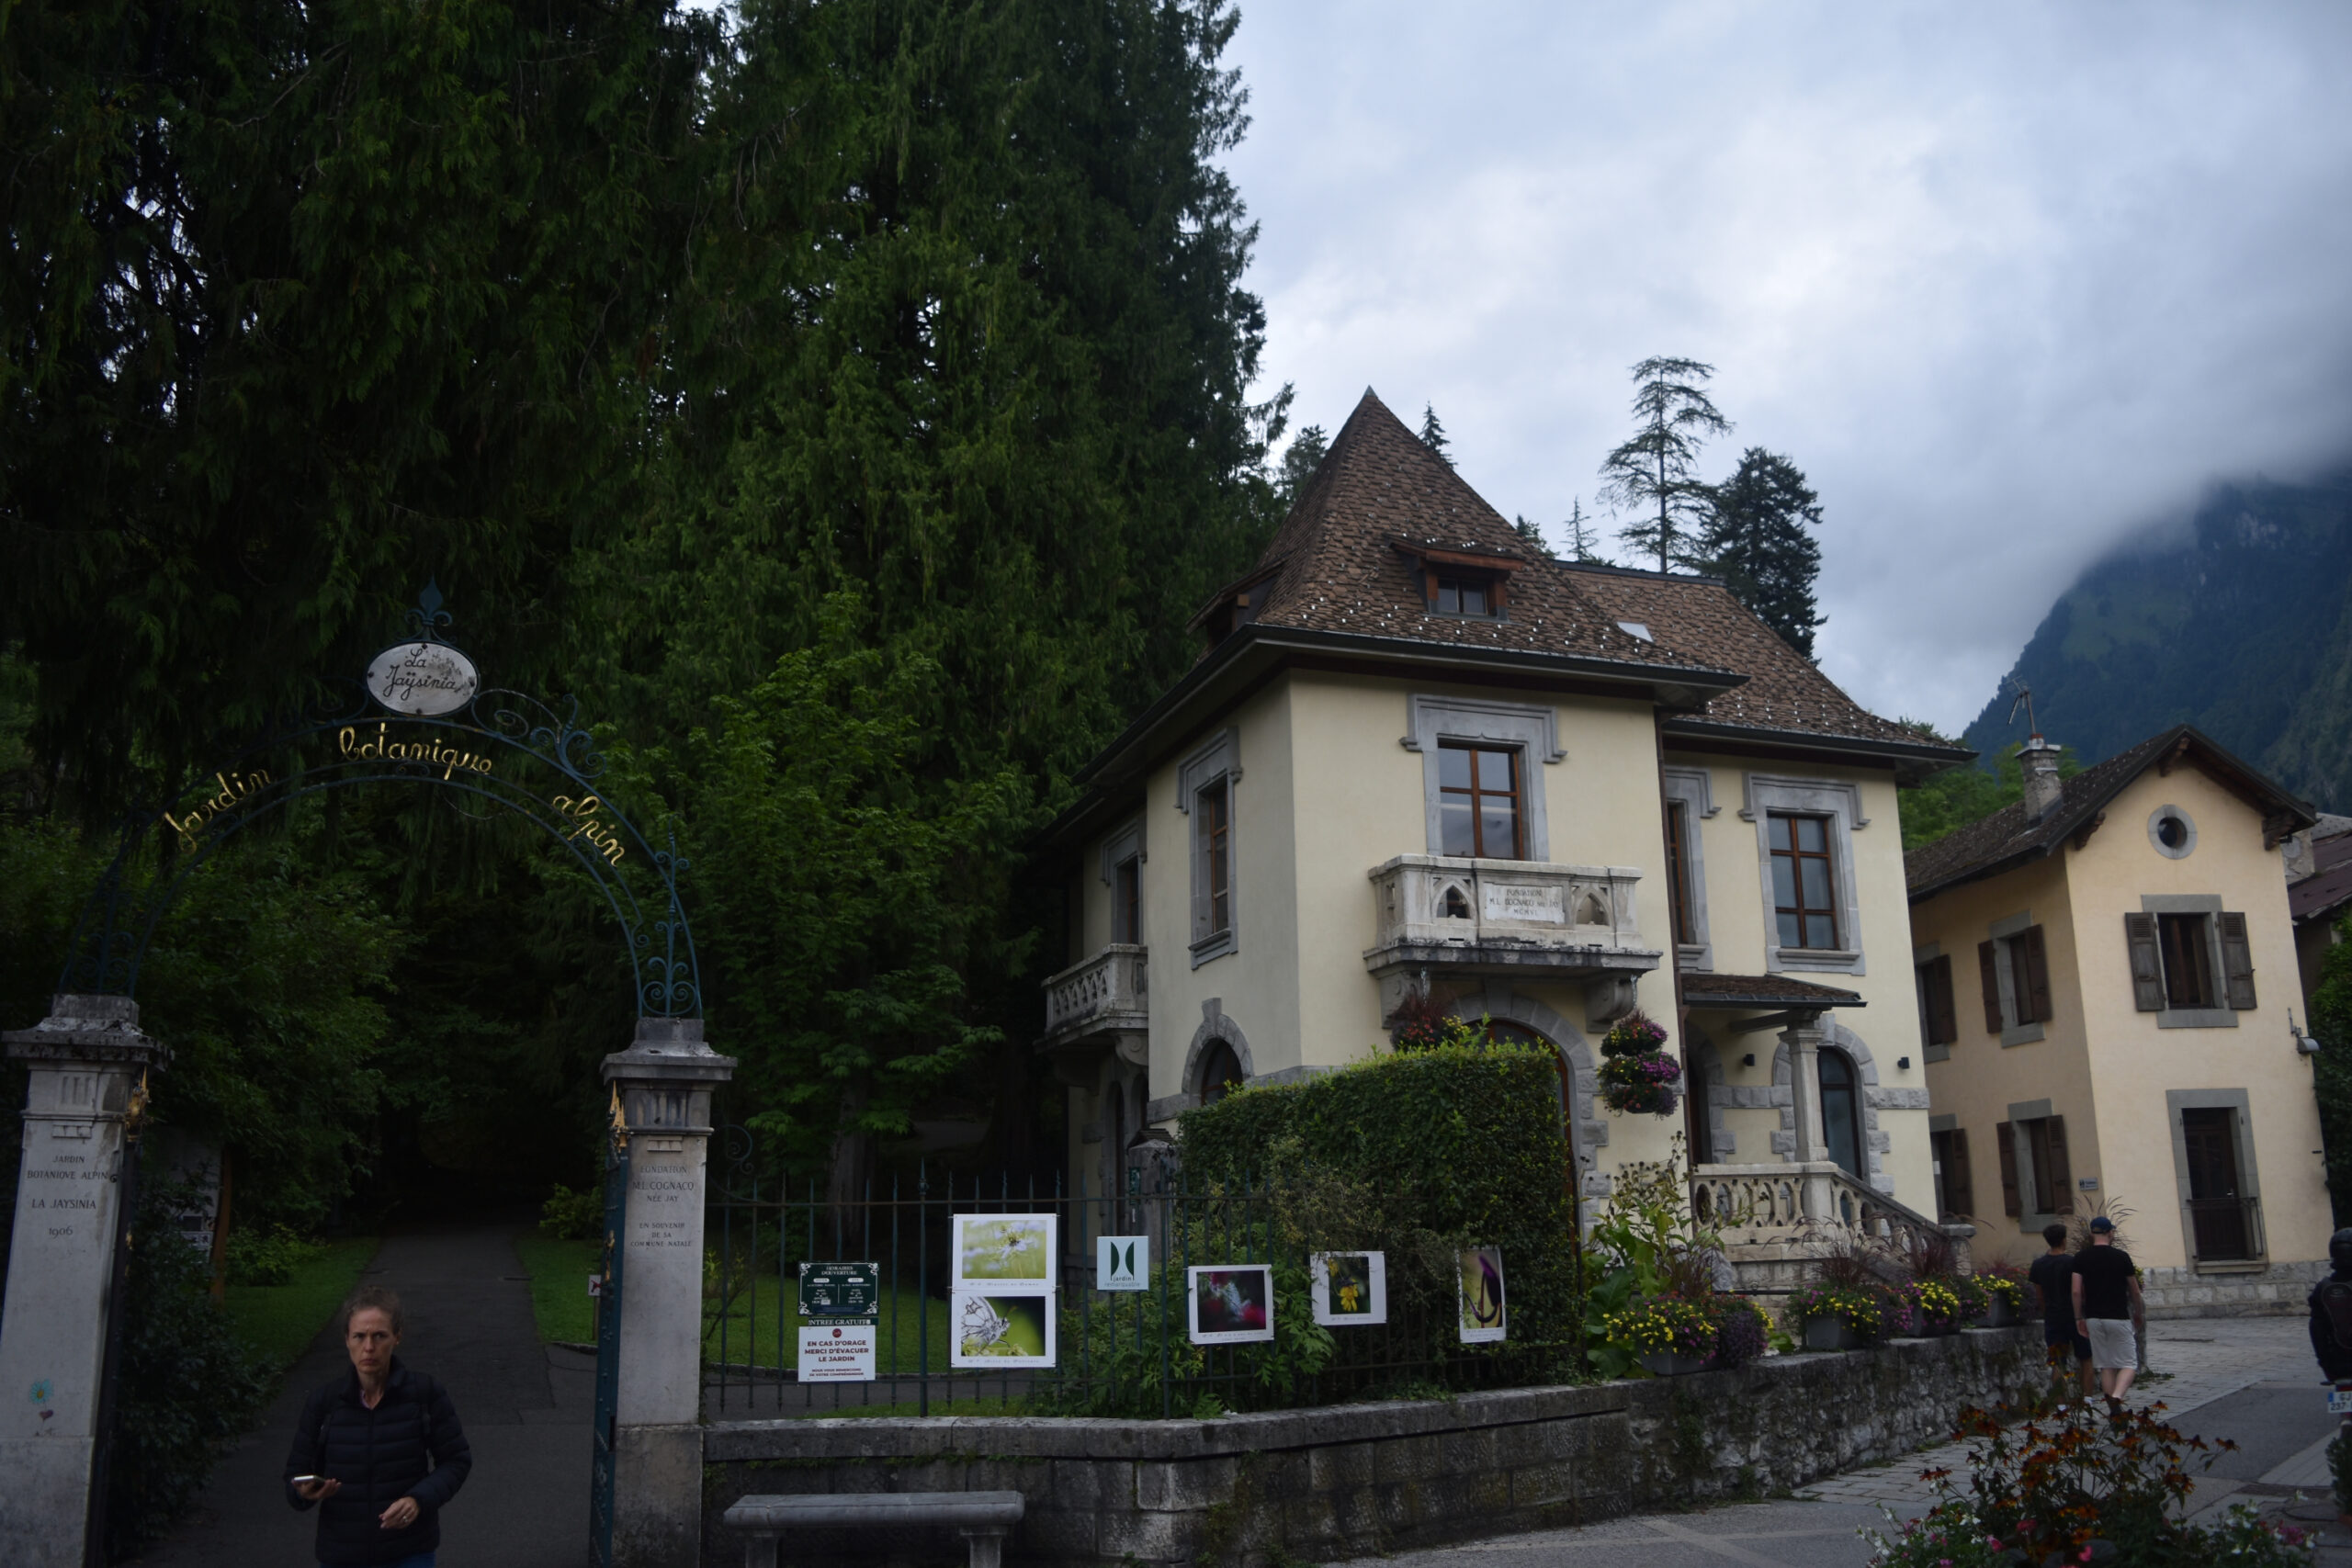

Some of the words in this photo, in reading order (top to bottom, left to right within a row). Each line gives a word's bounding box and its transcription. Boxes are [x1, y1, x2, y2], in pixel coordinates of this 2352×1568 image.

[404, 648, 427, 669] La
[163, 769, 272, 855] Jardin
[338, 722, 493, 781] botanique
[551, 795, 626, 868] alpin
[51, 1155, 85, 1164] JARDIN
[81, 1170, 109, 1180] ALPIN
[639, 1165, 687, 1174] FONDATION
[649, 1180, 695, 1191] COGNACQ
[31, 1198, 45, 1209] LA
[50, 1198, 96, 1210] JAYSINIA
[49, 1225, 74, 1239] 1906
